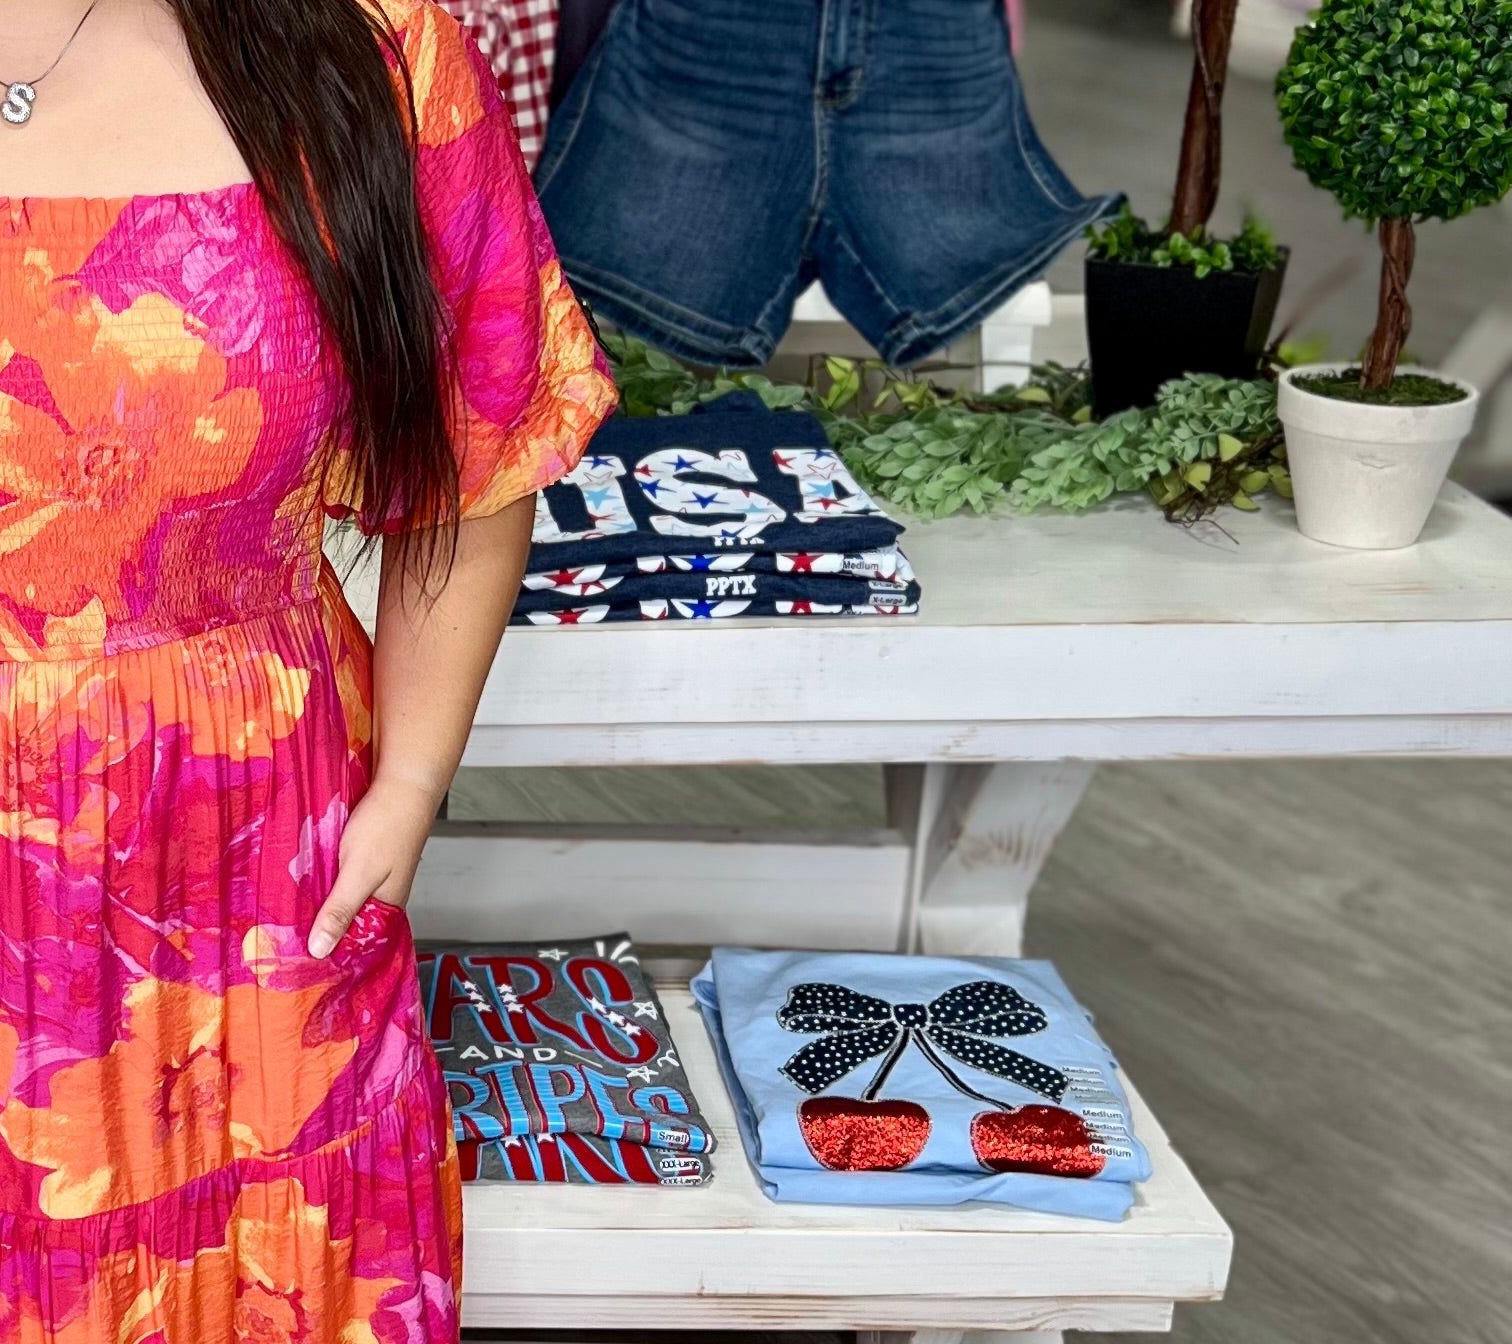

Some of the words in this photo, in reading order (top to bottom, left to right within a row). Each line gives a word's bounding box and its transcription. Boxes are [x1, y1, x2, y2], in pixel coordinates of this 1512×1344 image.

[842, 560, 879, 571] Medium
[705, 574, 757, 597] PPTX
[459, 1045, 557, 1061] AND
[1082, 1108, 1123, 1119] Medium
[658, 1130, 688, 1142] Small
[1091, 1145, 1132, 1158] Medium
